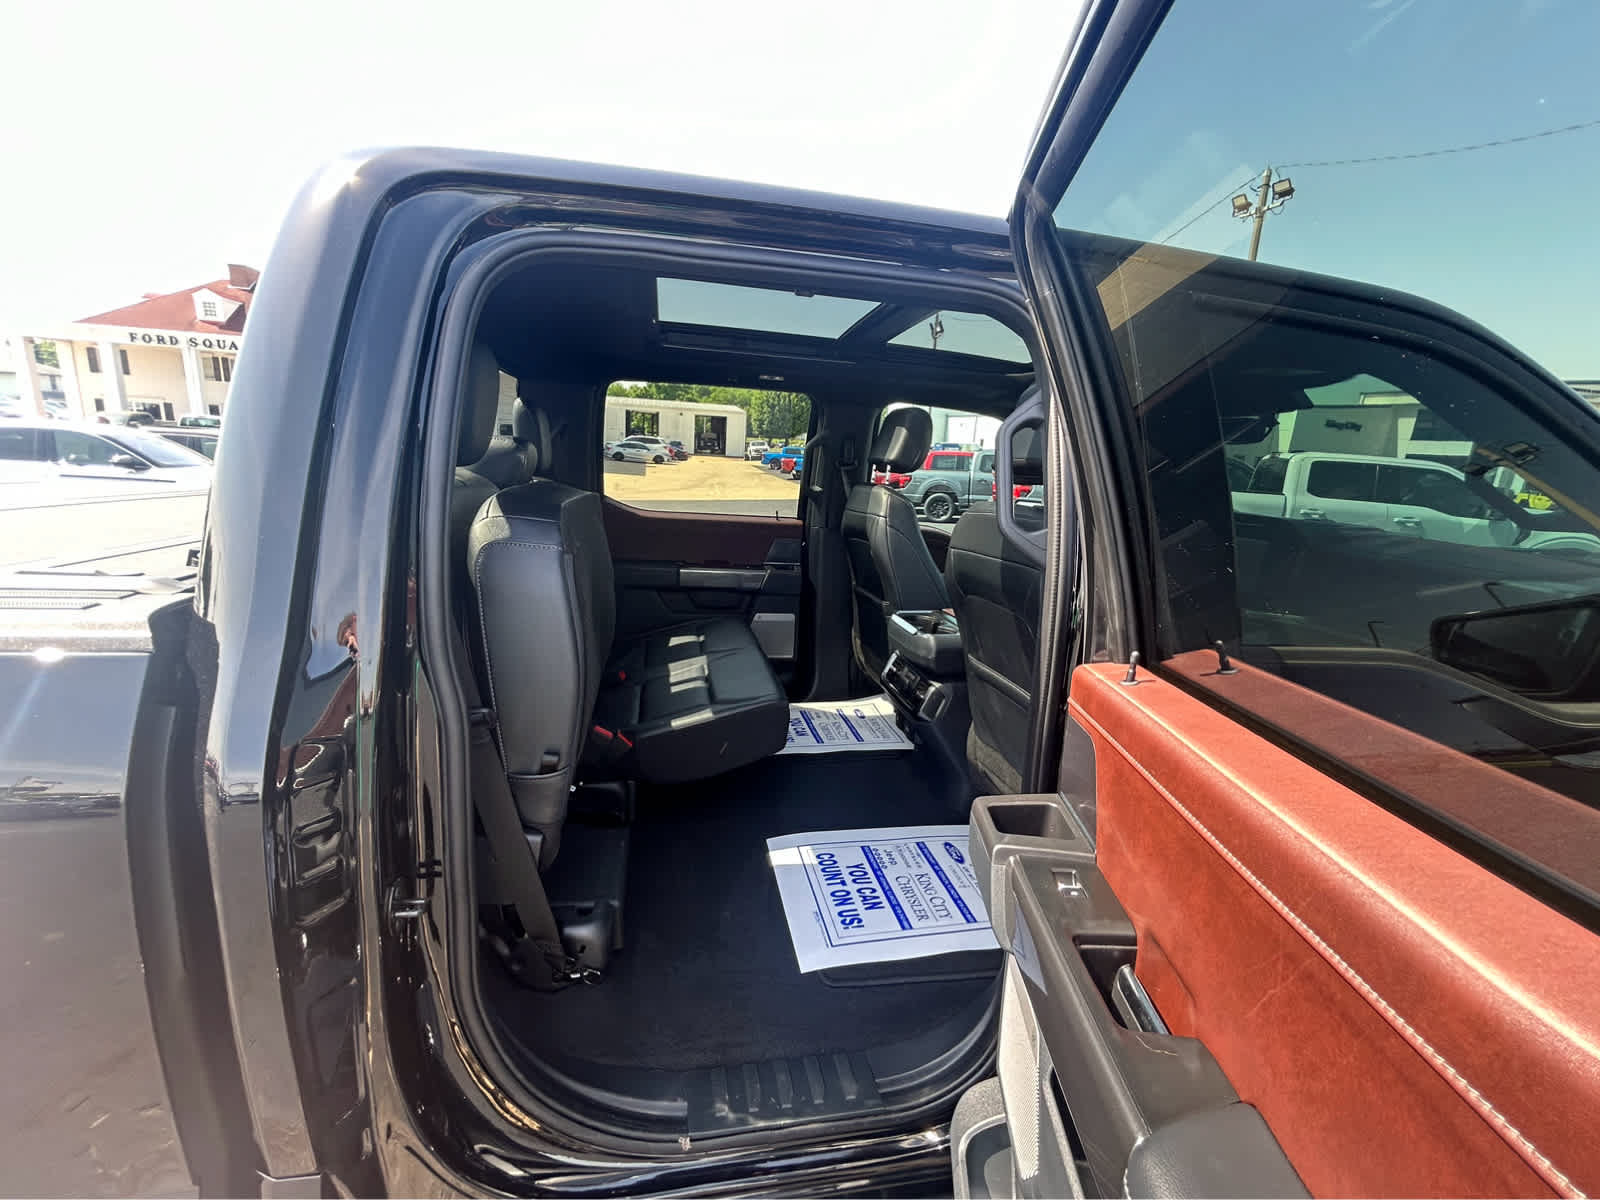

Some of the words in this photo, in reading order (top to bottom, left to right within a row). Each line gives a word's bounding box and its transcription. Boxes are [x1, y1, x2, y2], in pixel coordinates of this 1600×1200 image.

[128, 332, 179, 346] FORD
[883, 849, 898, 866] Jeep
[816, 853, 847, 886] COUNT
[845, 863, 873, 884] YOU
[830, 889, 855, 907] ON
[856, 887, 885, 910] CAN
[895, 875, 929, 921] CHRYSLER
[914, 872, 937, 896] KING
[929, 896, 952, 919] CITY
[837, 908, 864, 930] US!
